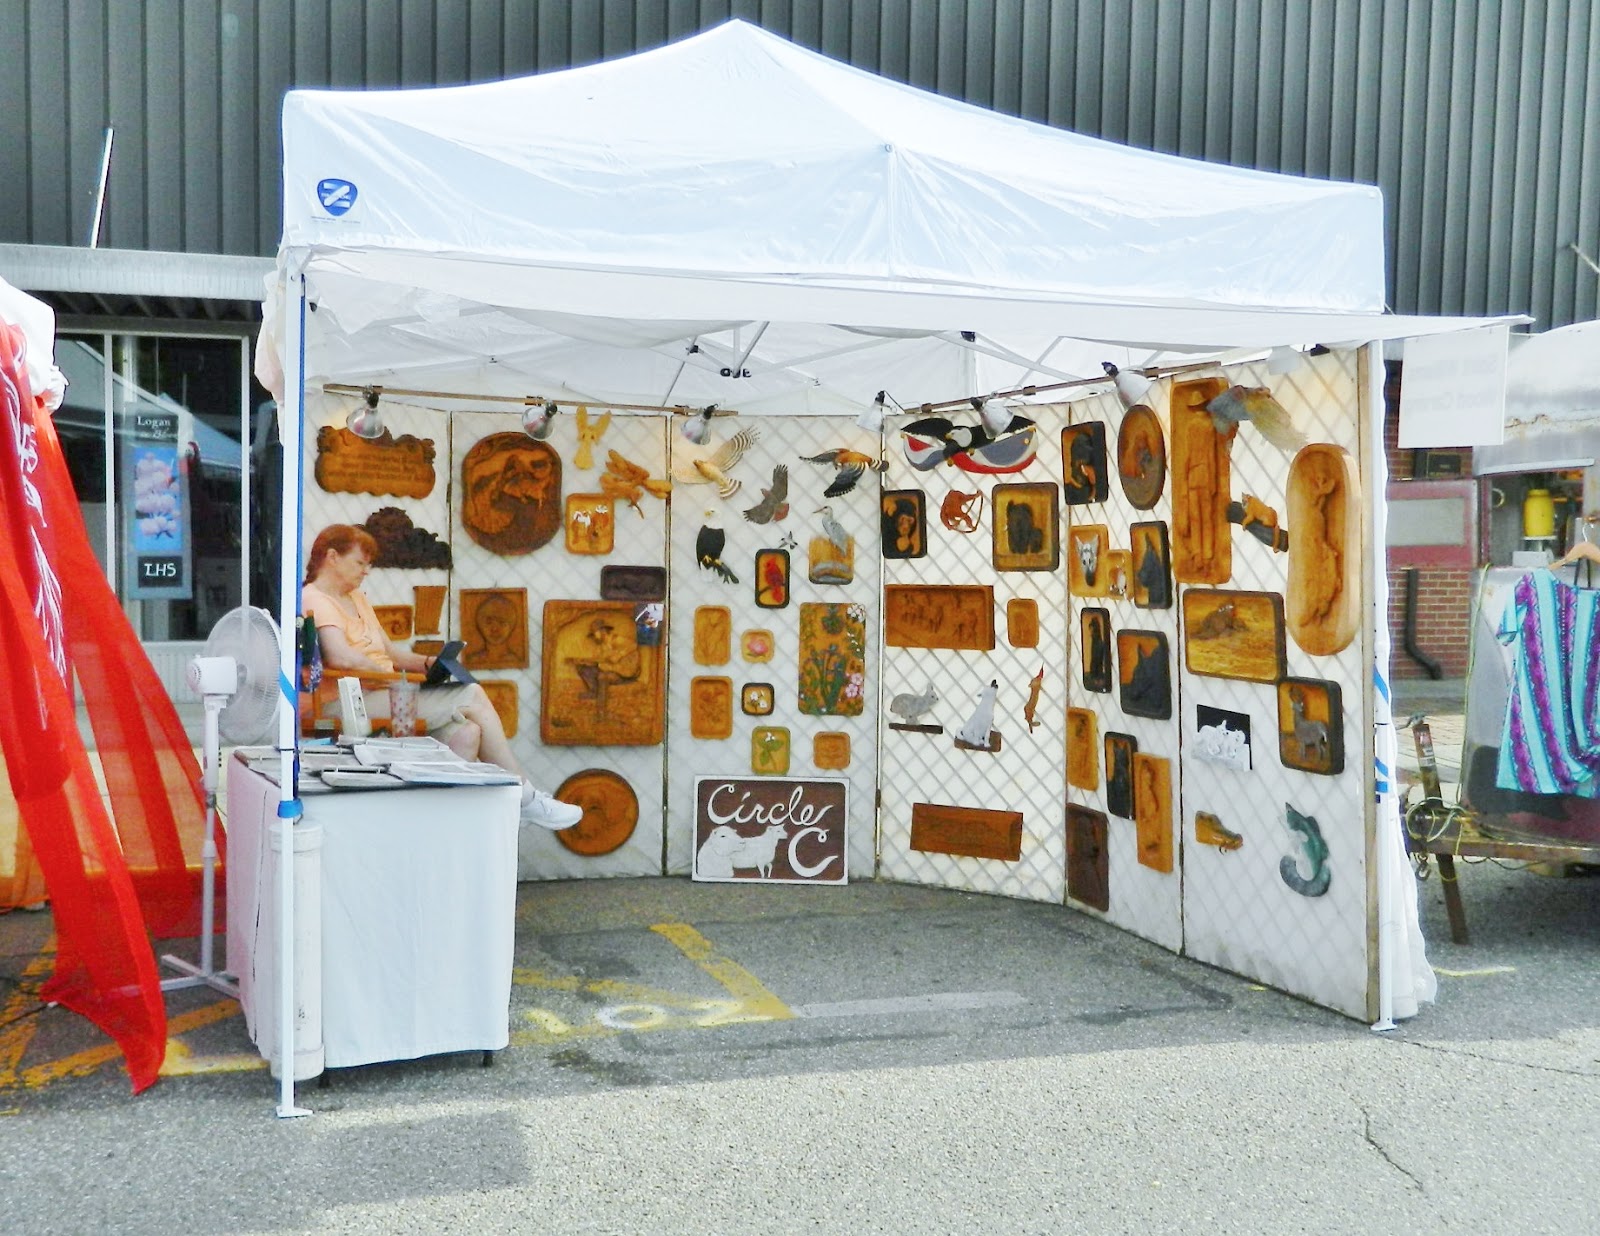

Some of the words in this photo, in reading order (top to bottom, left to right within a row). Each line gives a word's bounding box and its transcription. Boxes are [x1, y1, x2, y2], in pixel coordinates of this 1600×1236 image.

[137, 415, 171, 429] Logan
[707, 783, 834, 826] Circle
[788, 826, 839, 878] C
